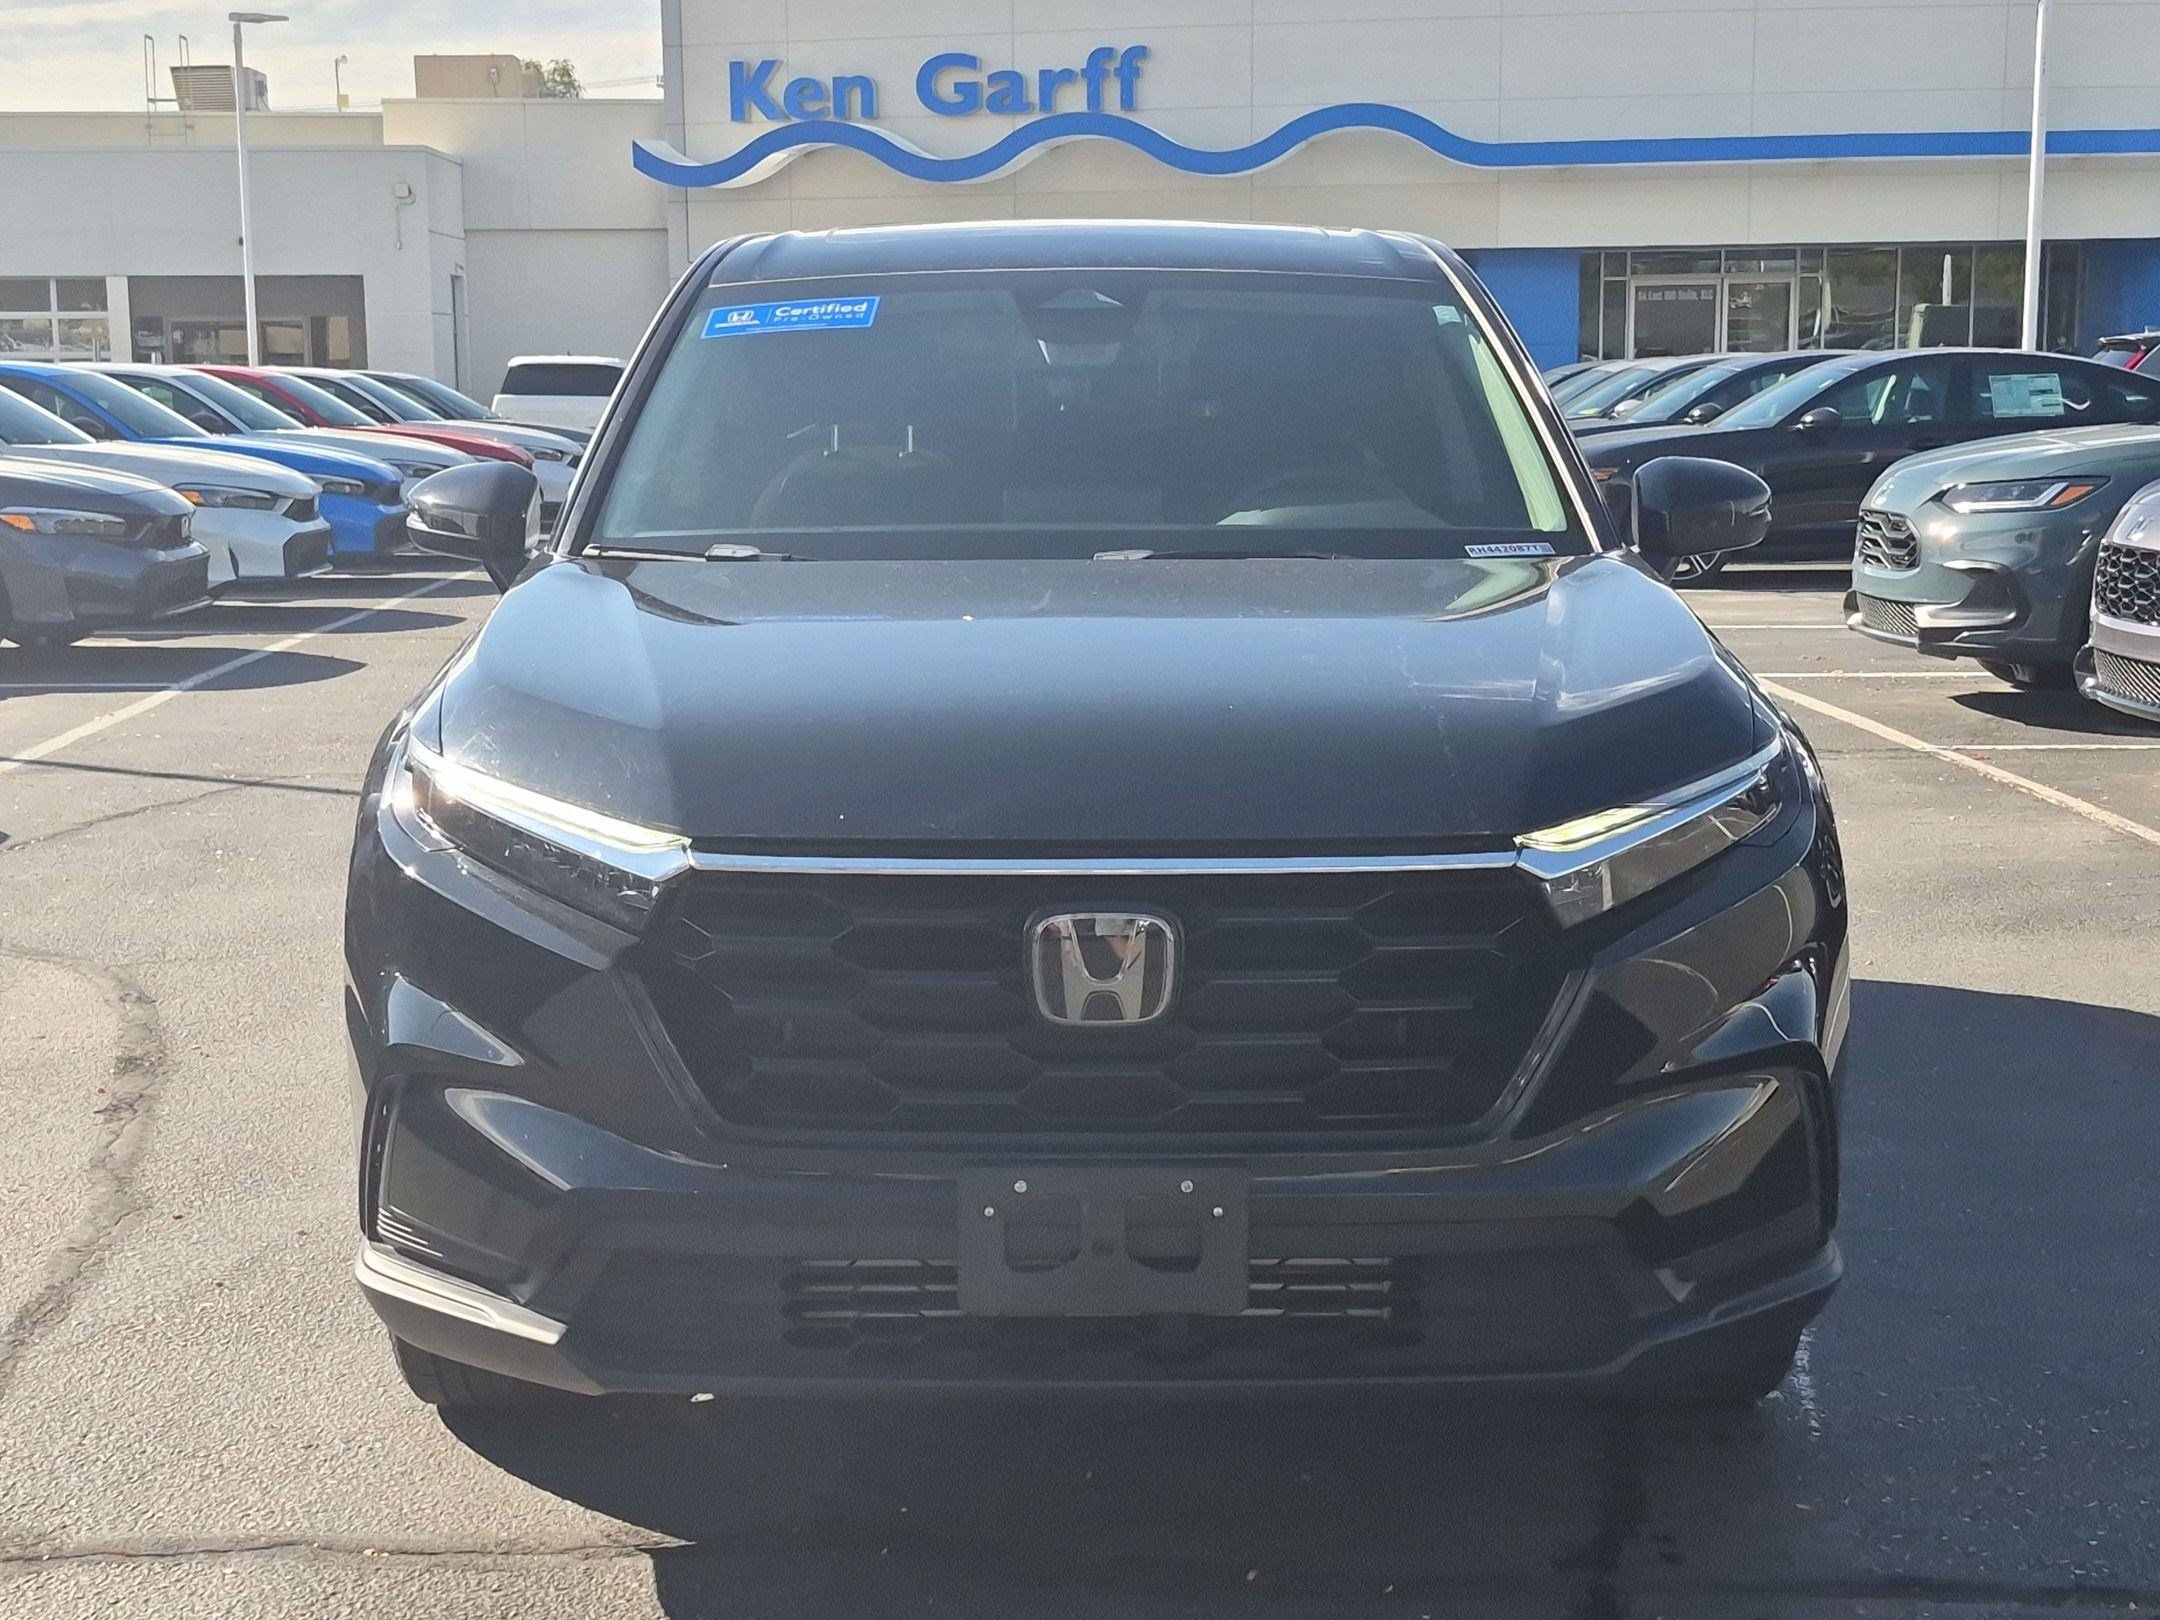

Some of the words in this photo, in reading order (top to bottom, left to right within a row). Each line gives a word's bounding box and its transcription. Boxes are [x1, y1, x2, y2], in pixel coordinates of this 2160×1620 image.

[729, 59, 878, 122] Ken
[915, 45, 1148, 116] Garff
[775, 301, 868, 317] Certified
[773, 312, 864, 323] Pre-Owned
